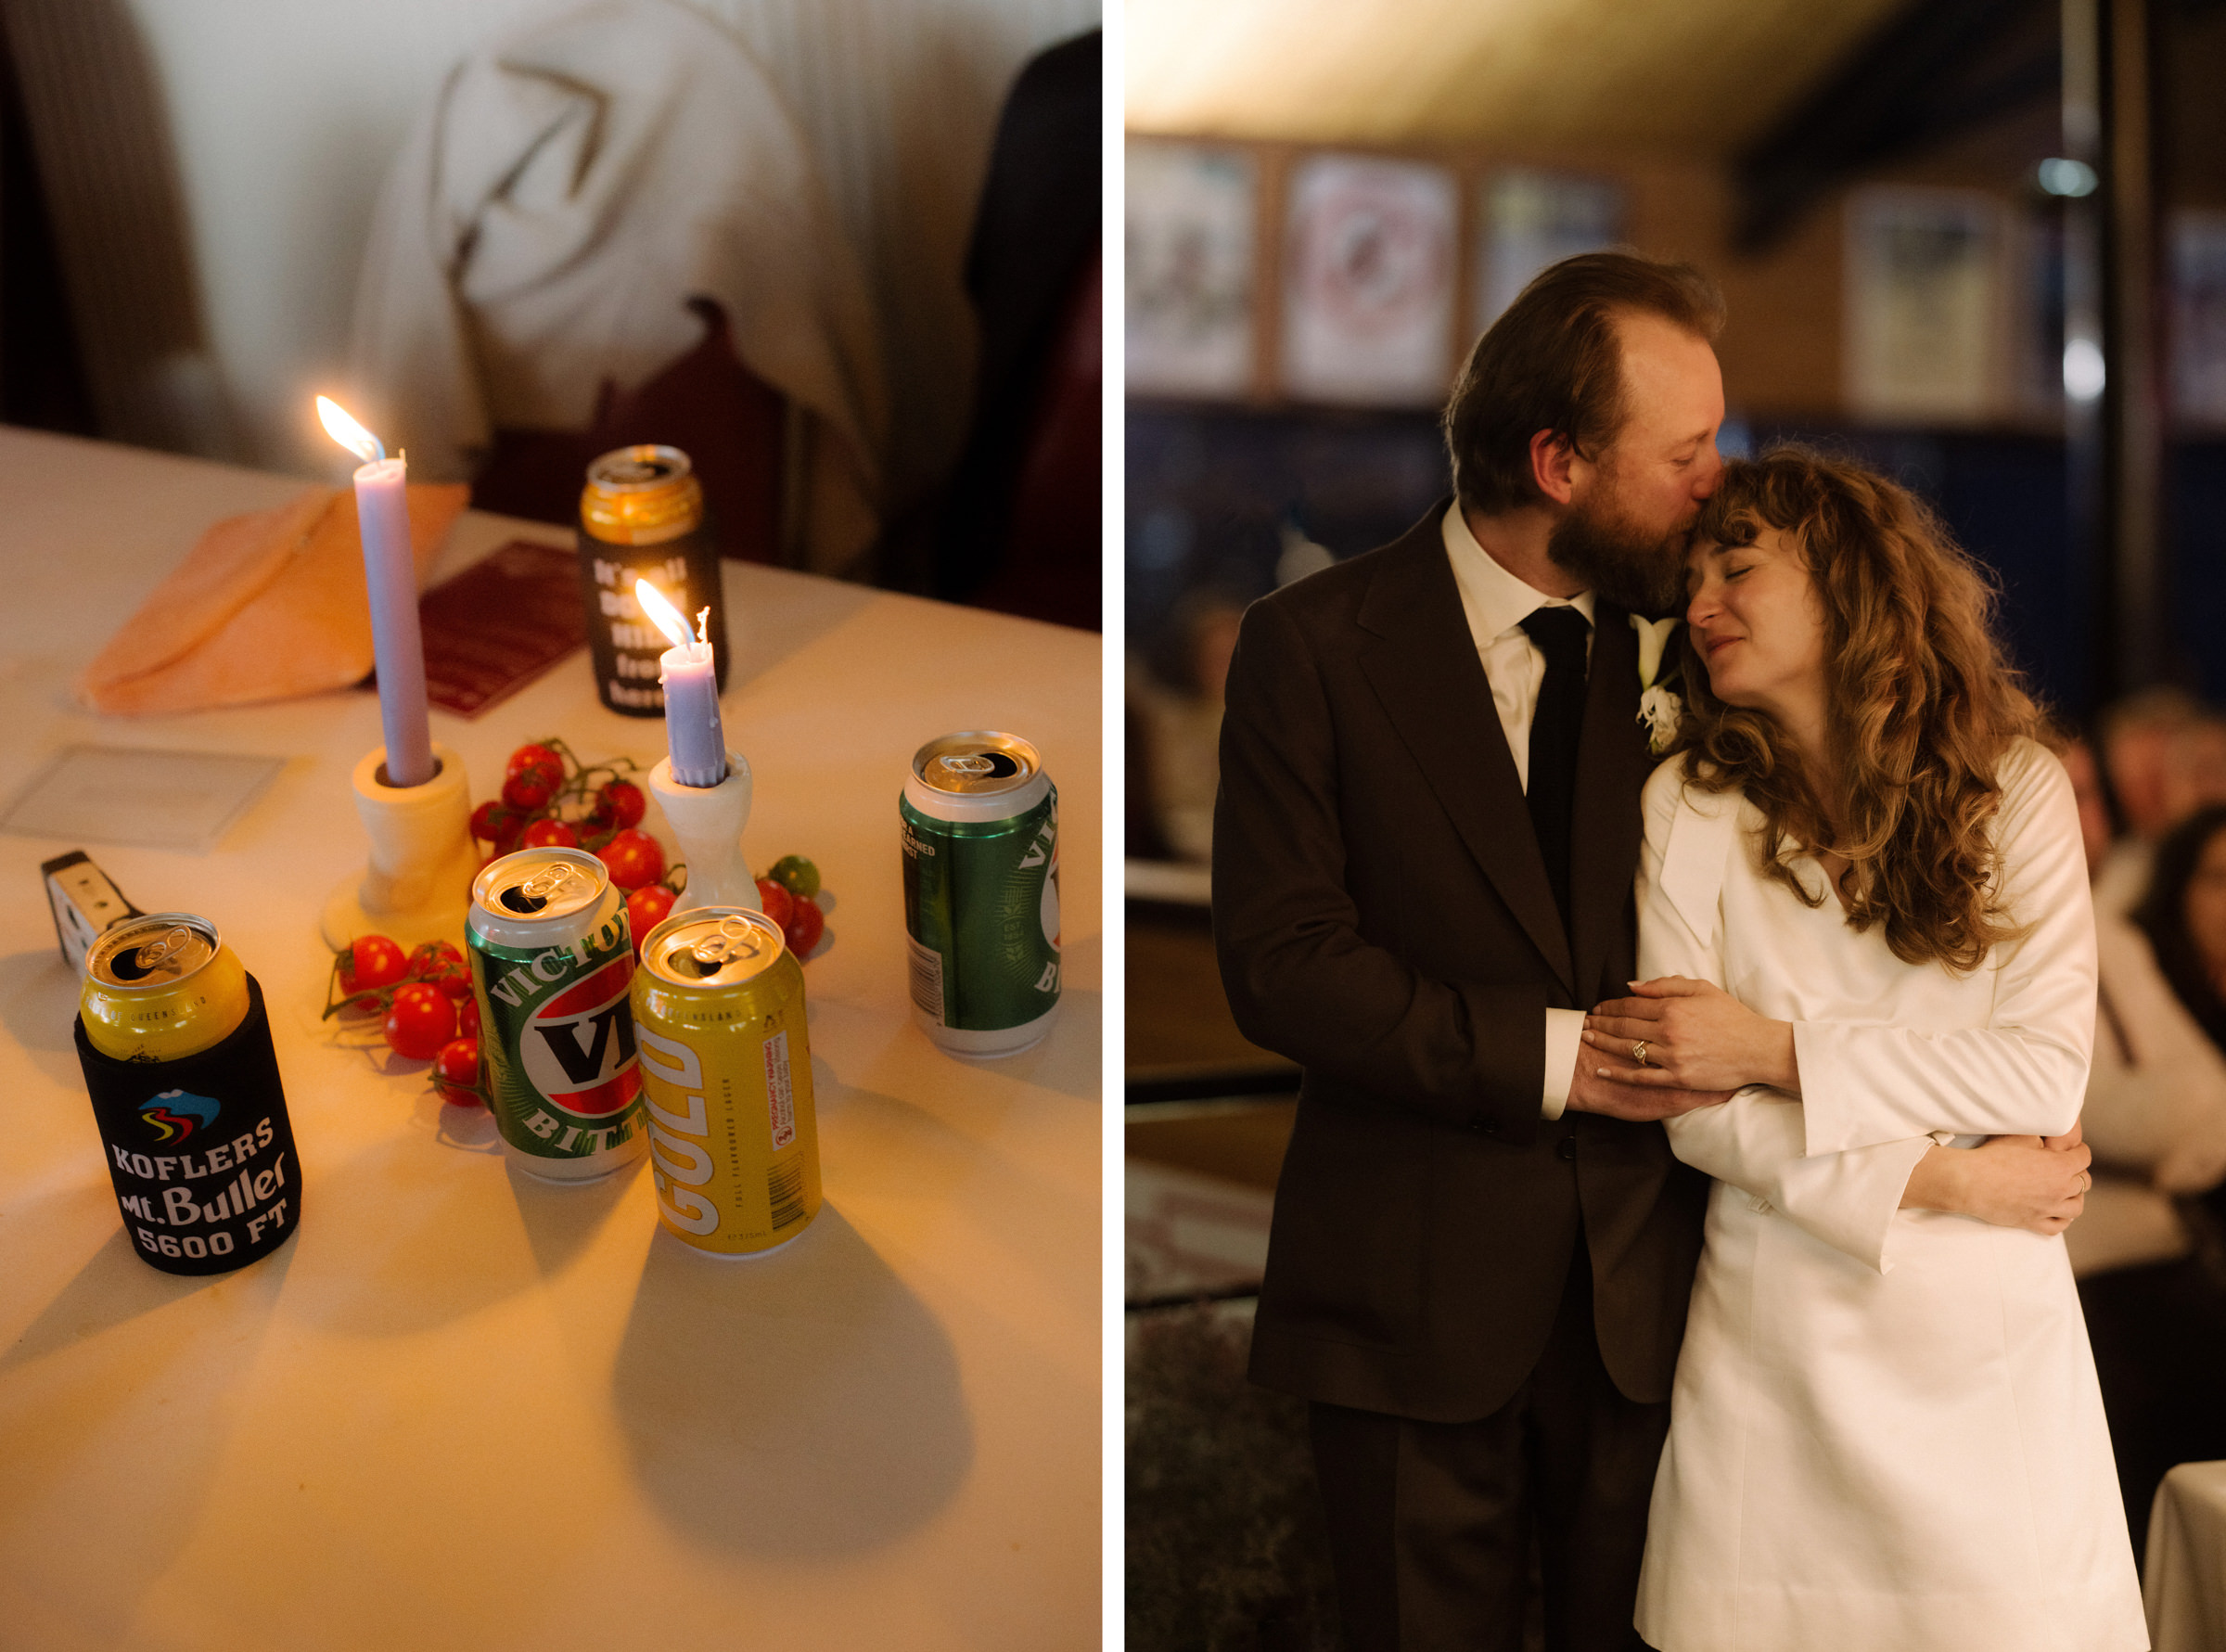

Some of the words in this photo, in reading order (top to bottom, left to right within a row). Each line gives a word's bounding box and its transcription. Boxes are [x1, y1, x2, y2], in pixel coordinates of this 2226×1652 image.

[130, 995, 207, 1022] QUEENSND
[111, 1117, 274, 1182] KOFLERS
[635, 1021, 720, 1236] GOLD
[135, 1225, 235, 1260] 5600
[246, 1197, 288, 1245] FT
